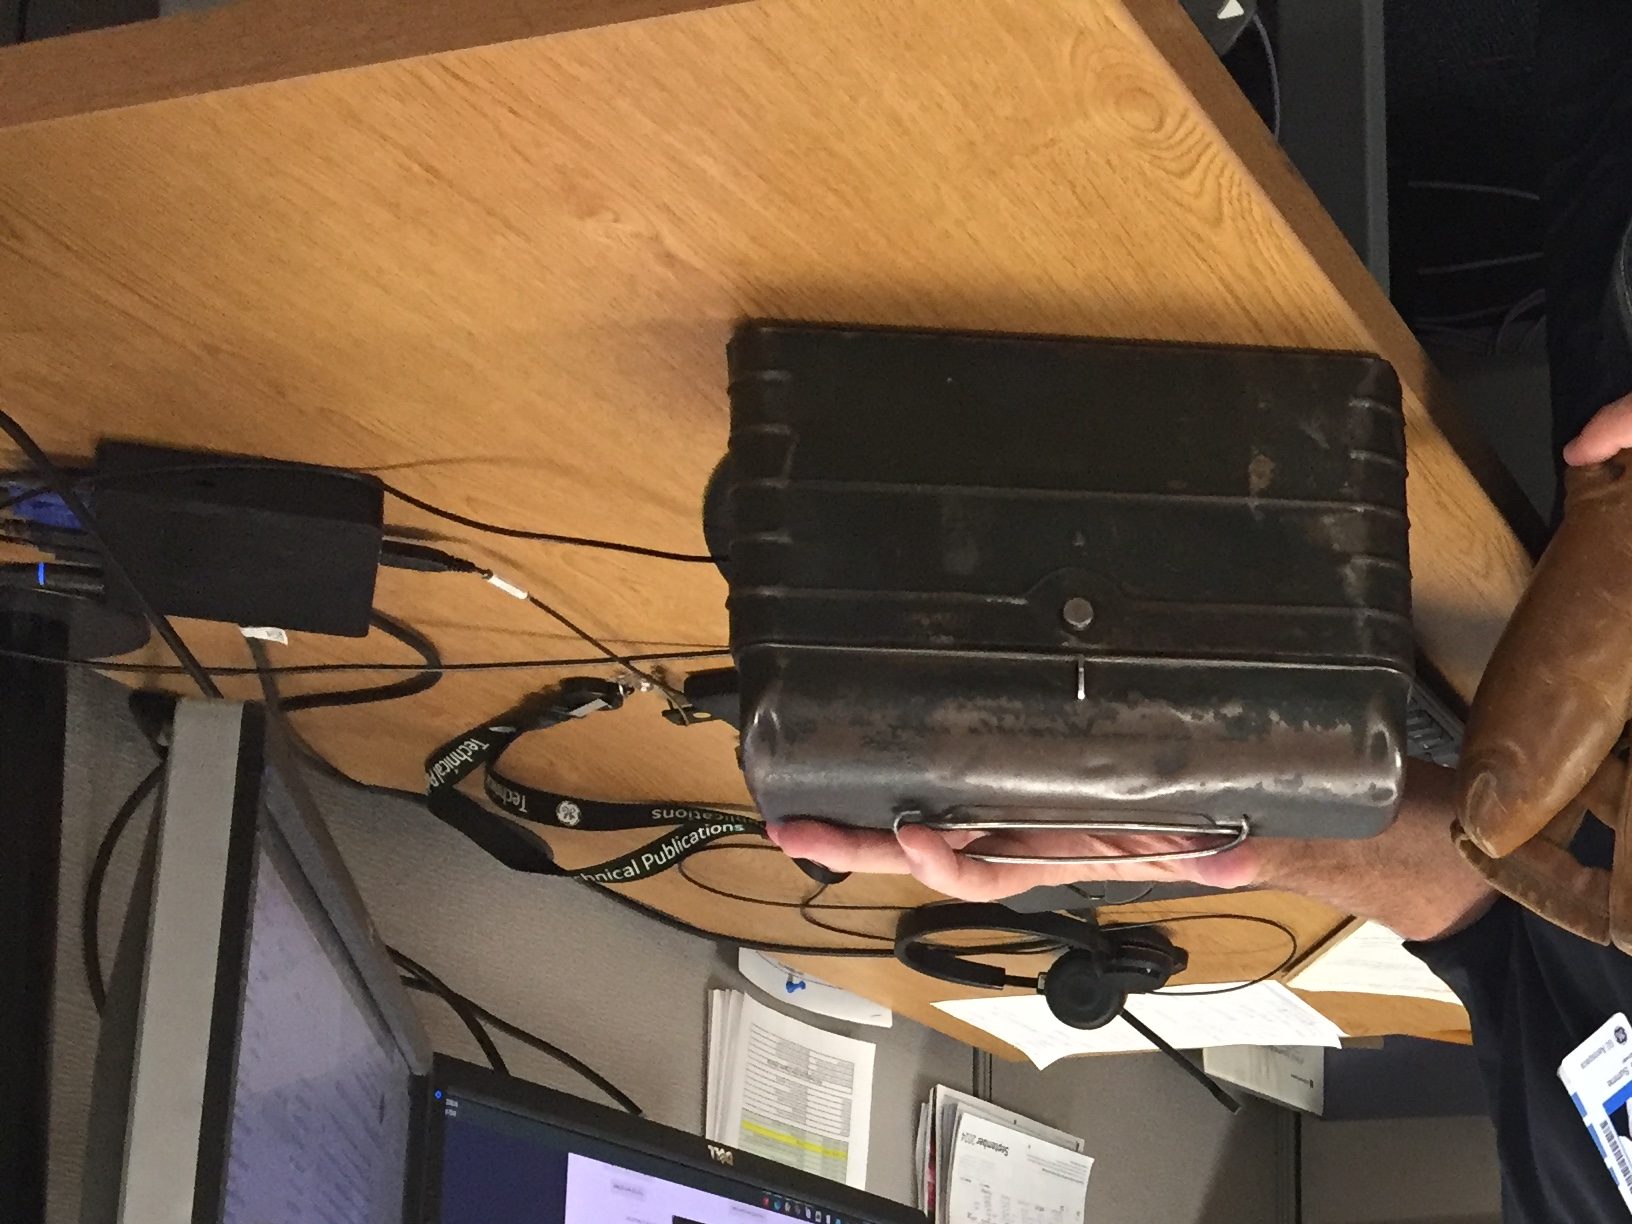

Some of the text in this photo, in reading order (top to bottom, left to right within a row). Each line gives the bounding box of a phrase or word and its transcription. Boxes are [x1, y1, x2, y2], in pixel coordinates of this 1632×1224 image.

[436, 737, 489, 784] Technical
[641, 823, 746, 870] Publications
[708, 1144, 734, 1166] DELL
[960, 1132, 1009, 1158] September 2024
